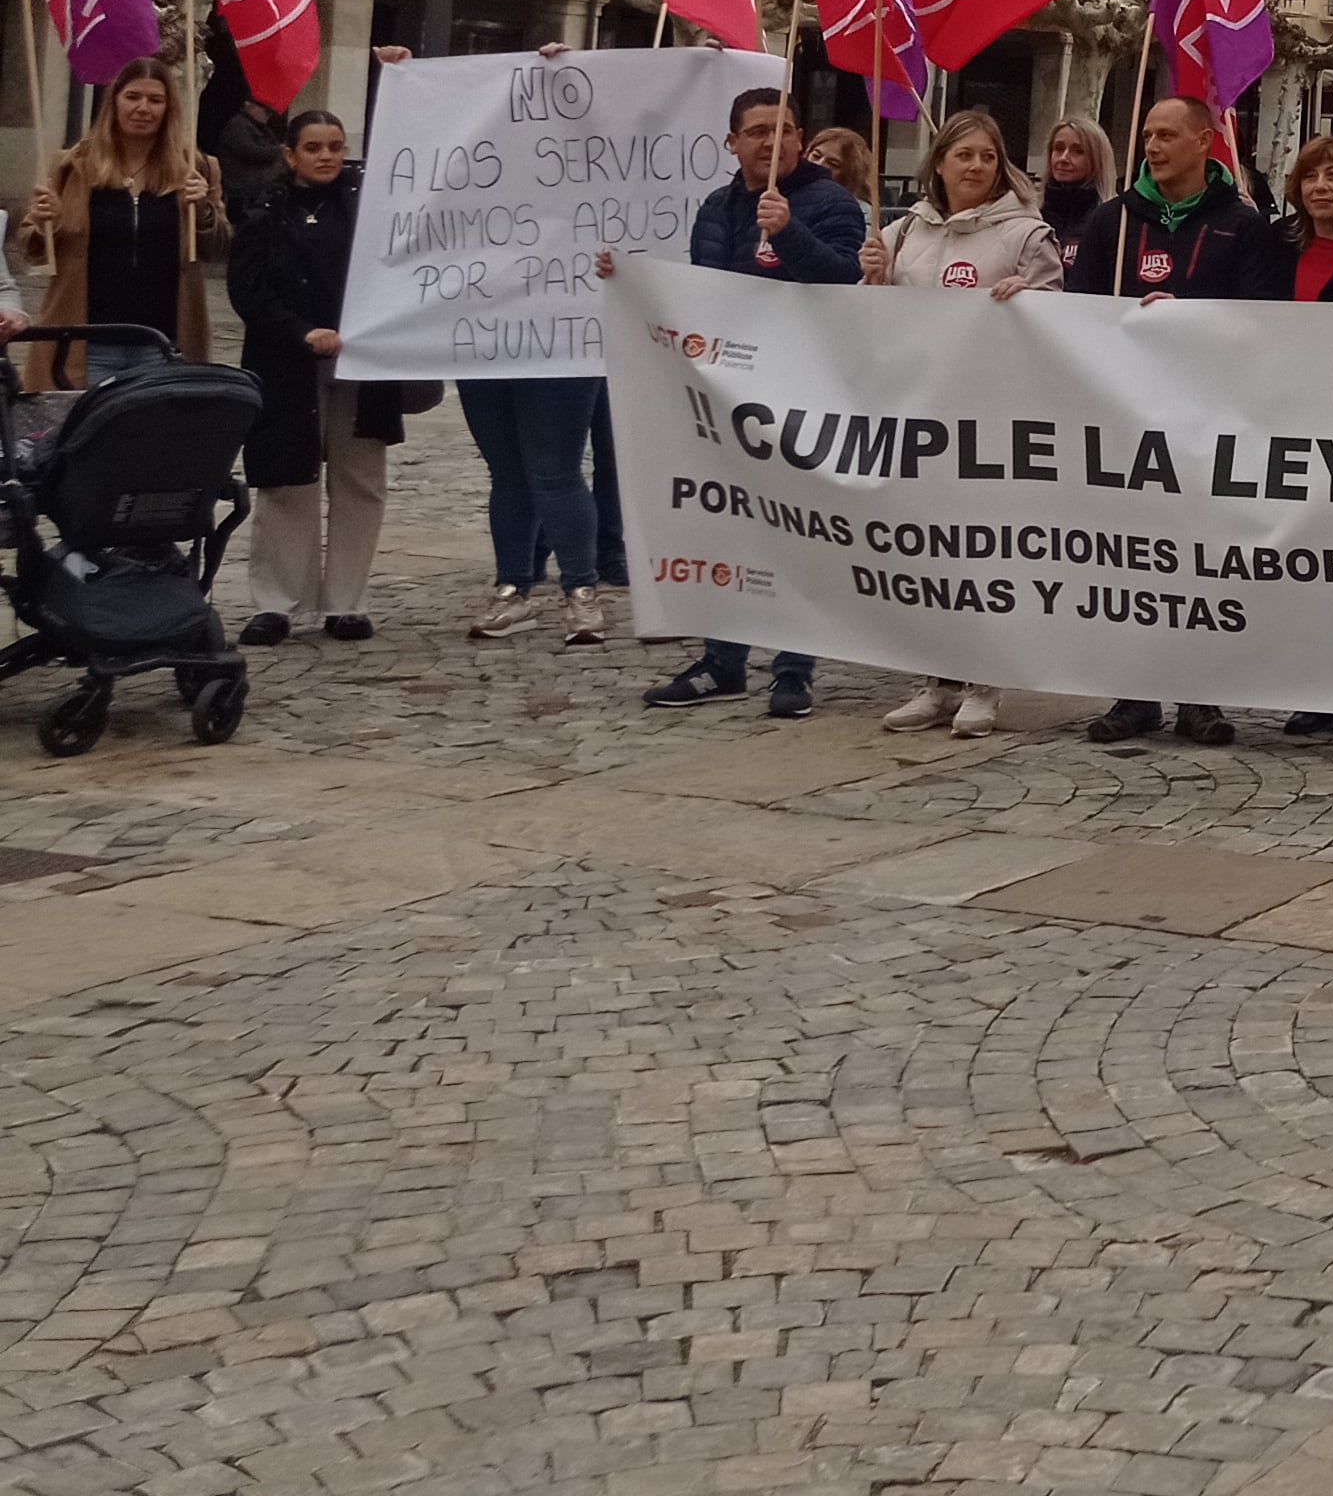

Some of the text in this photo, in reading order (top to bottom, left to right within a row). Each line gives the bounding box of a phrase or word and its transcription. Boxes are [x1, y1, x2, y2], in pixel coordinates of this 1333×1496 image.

[510, 66, 593, 122] NO
[390, 147, 416, 195] A
[429, 140, 503, 192] LOS
[388, 195, 702, 256] MÍNIMOS ABUSI
[413, 252, 600, 304] POR PAR
[453, 316, 604, 363] AYUNTA
[731, 402, 1058, 482] CUMPLE
[1084, 425, 1182, 494] LA
[672, 477, 755, 519] POR
[758, 495, 854, 547] UNAS
[865, 520, 1179, 574] CONDICIONES
[851, 565, 1247, 633] DIGNAS Y JUSTAS
